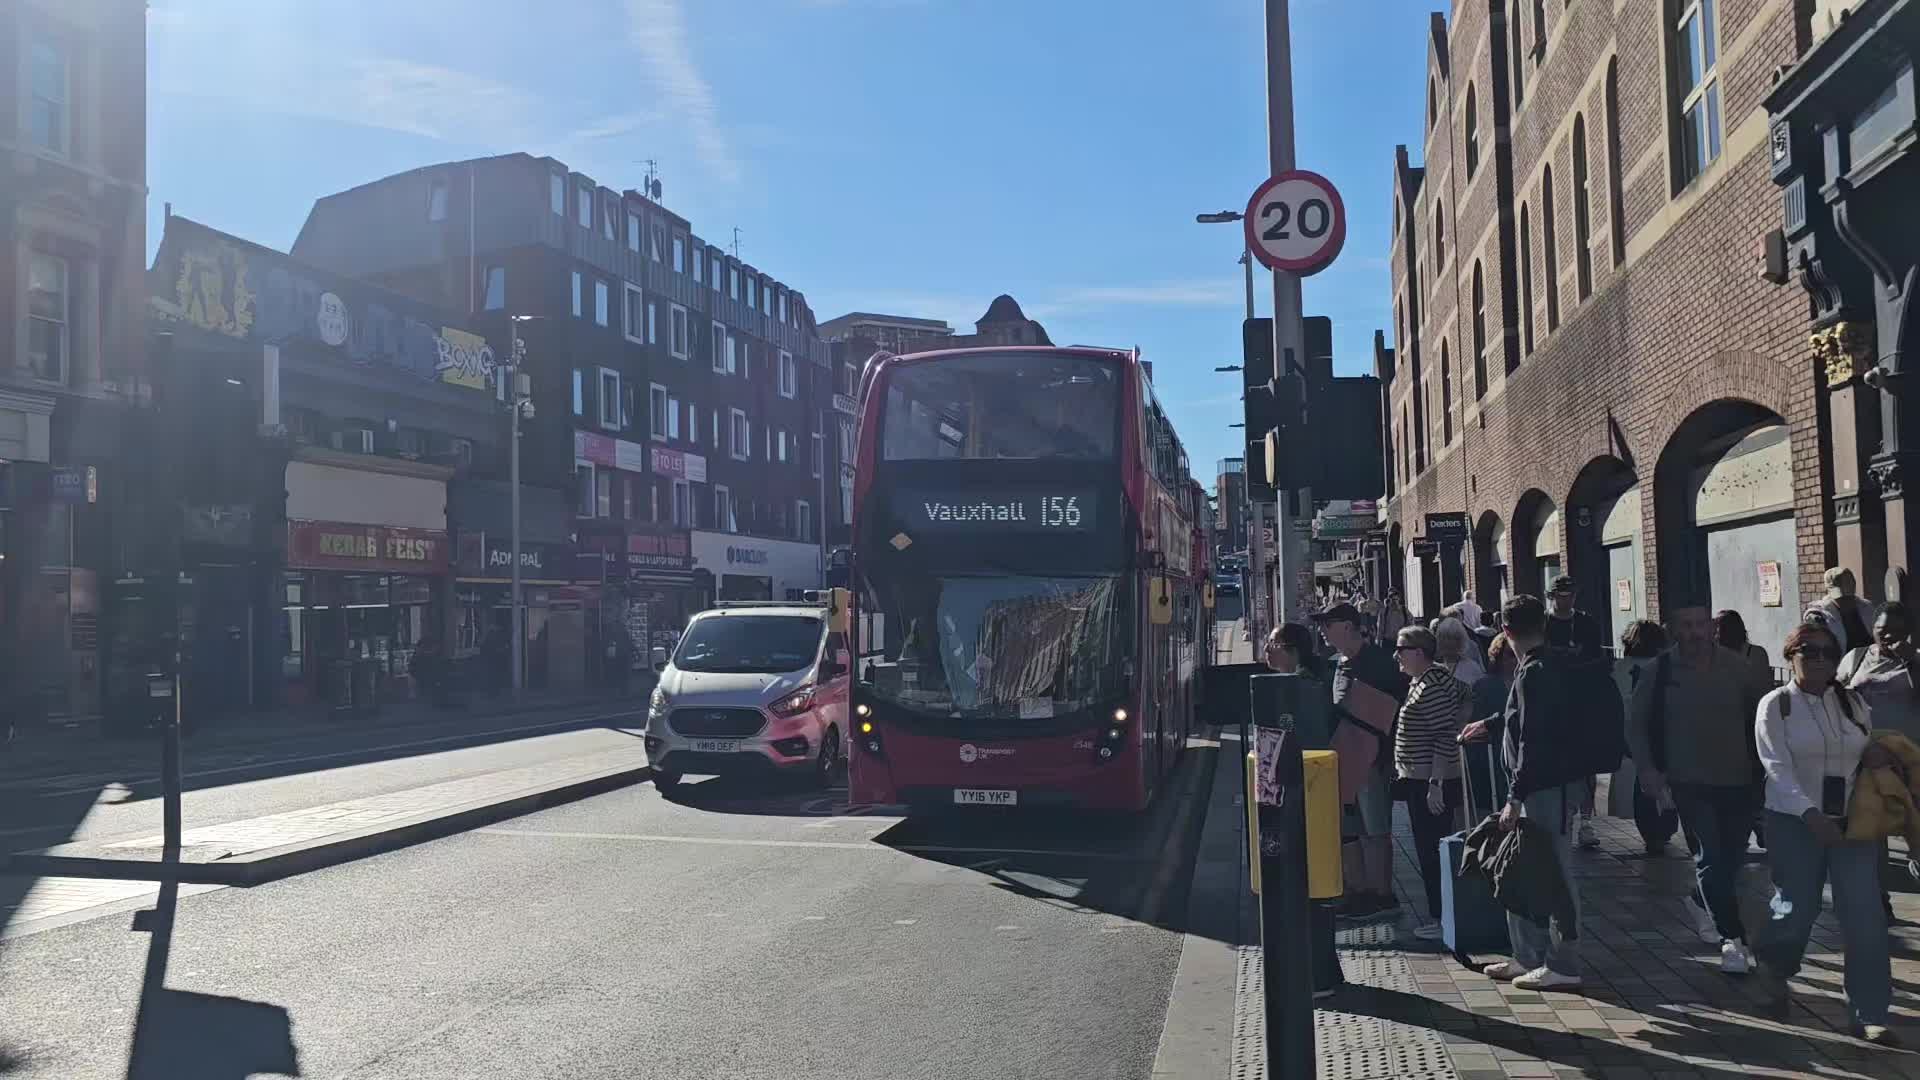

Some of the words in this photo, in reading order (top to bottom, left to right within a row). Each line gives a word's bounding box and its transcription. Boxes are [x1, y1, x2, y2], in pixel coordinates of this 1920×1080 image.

[1261, 198, 1330, 241] 20
[924, 502, 1026, 521] Vauxhall
[1041, 496, 1081, 526] 156
[1430, 520, 1462, 528] Dexters
[319, 533, 377, 558] KEBAB
[386, 537, 436, 561] FEAST
[961, 791, 986, 802] YY16
[989, 791, 1010, 803] YKP
